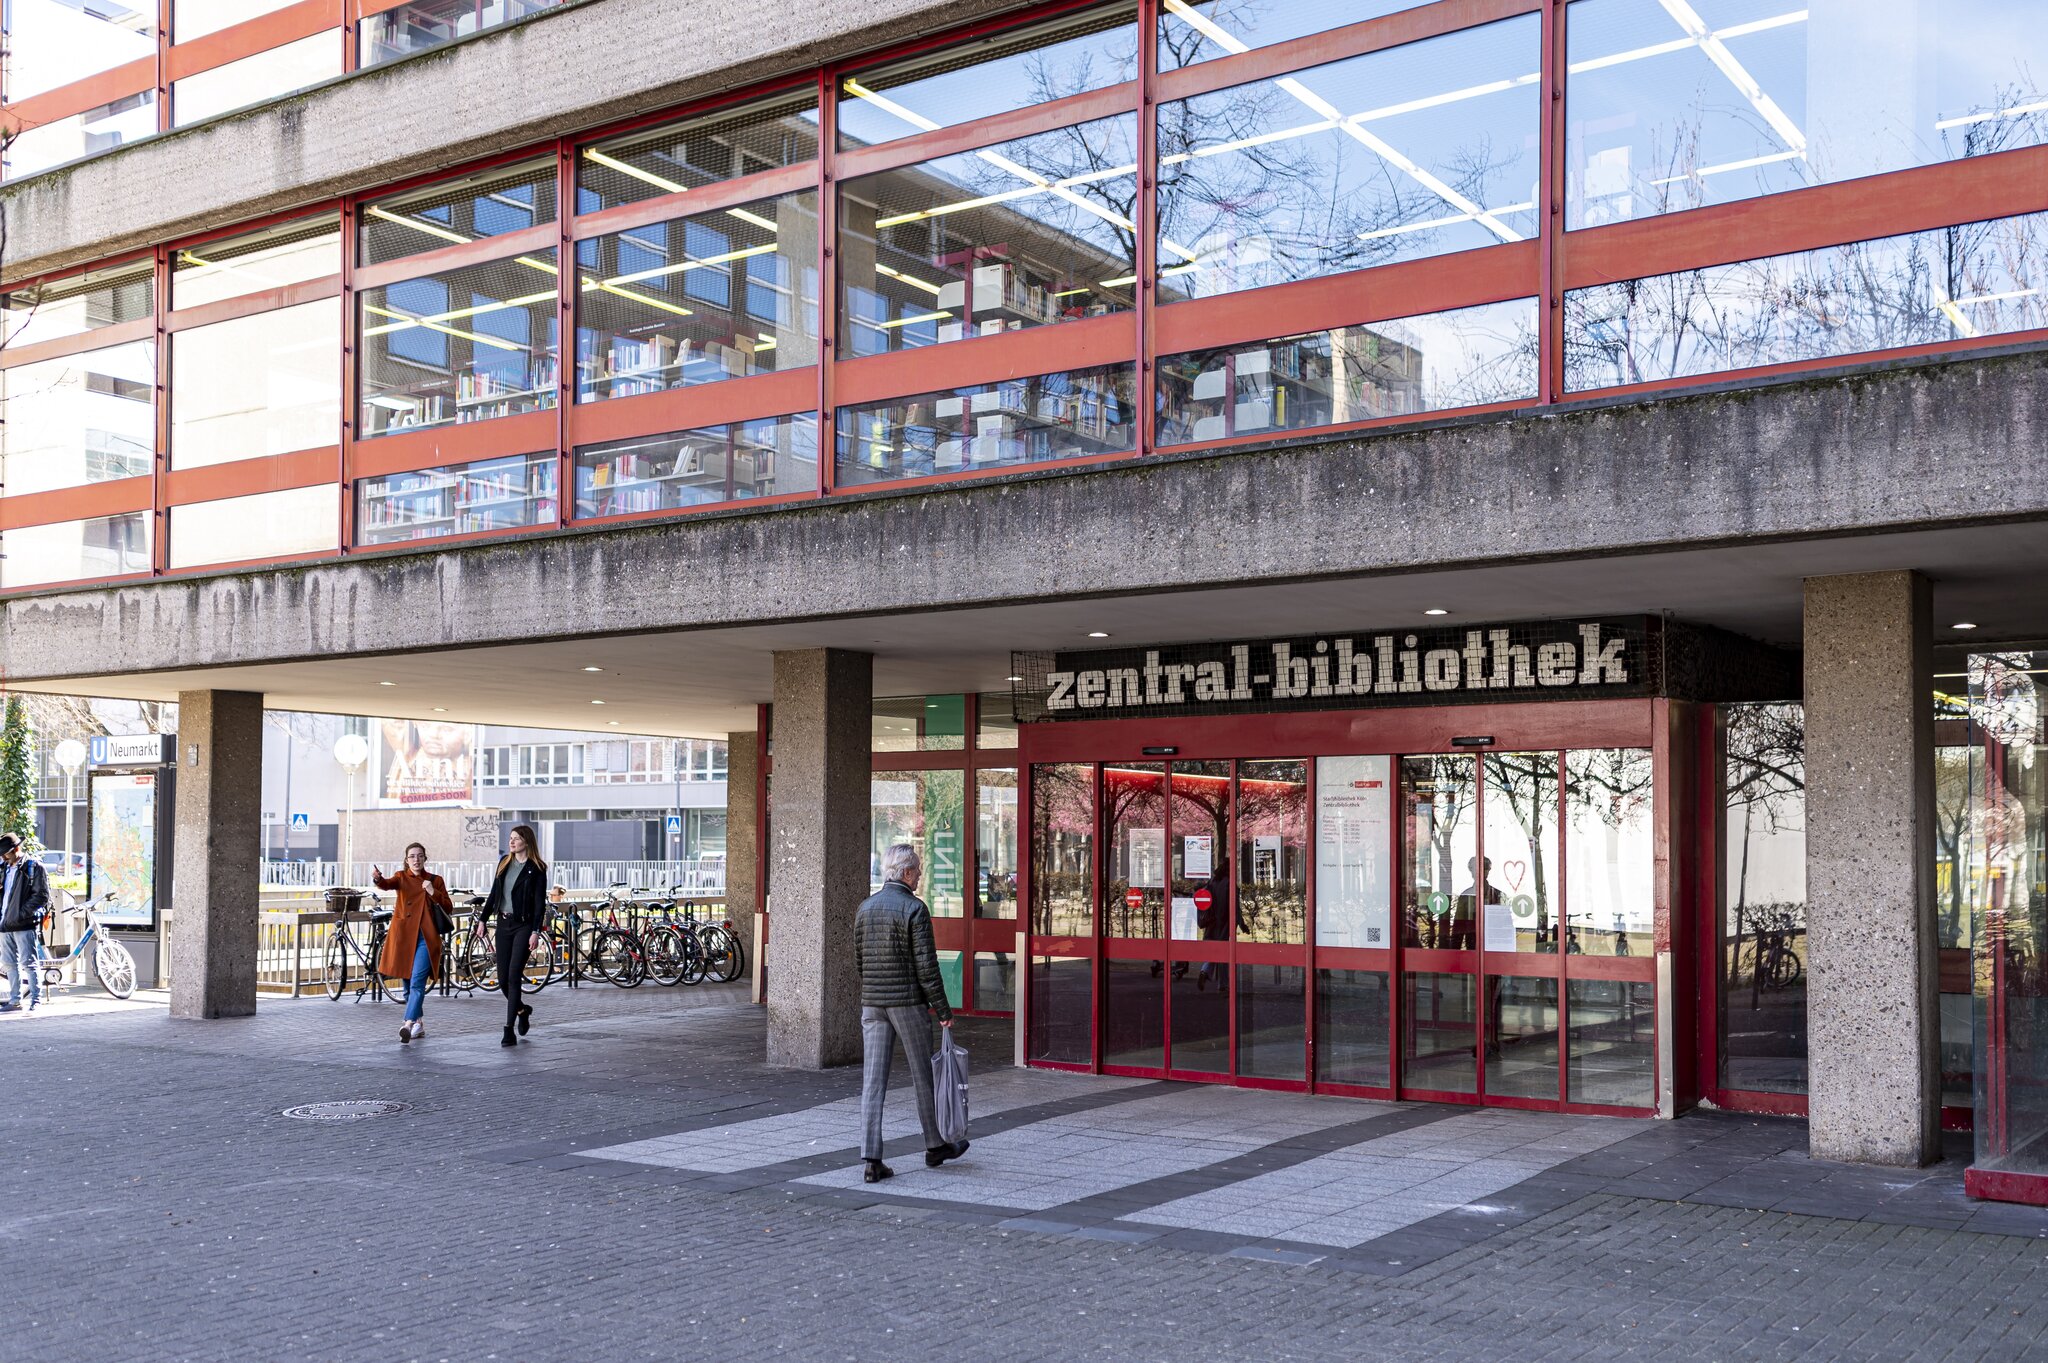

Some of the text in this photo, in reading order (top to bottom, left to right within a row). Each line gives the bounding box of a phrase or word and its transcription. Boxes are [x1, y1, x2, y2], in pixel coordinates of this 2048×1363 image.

[1047, 623, 1627, 710] zentral-bibliothek
[92, 740, 158, 762] U Neumarkt
[401, 794, 438, 804] COMING
[440, 791, 467, 801] SOON
